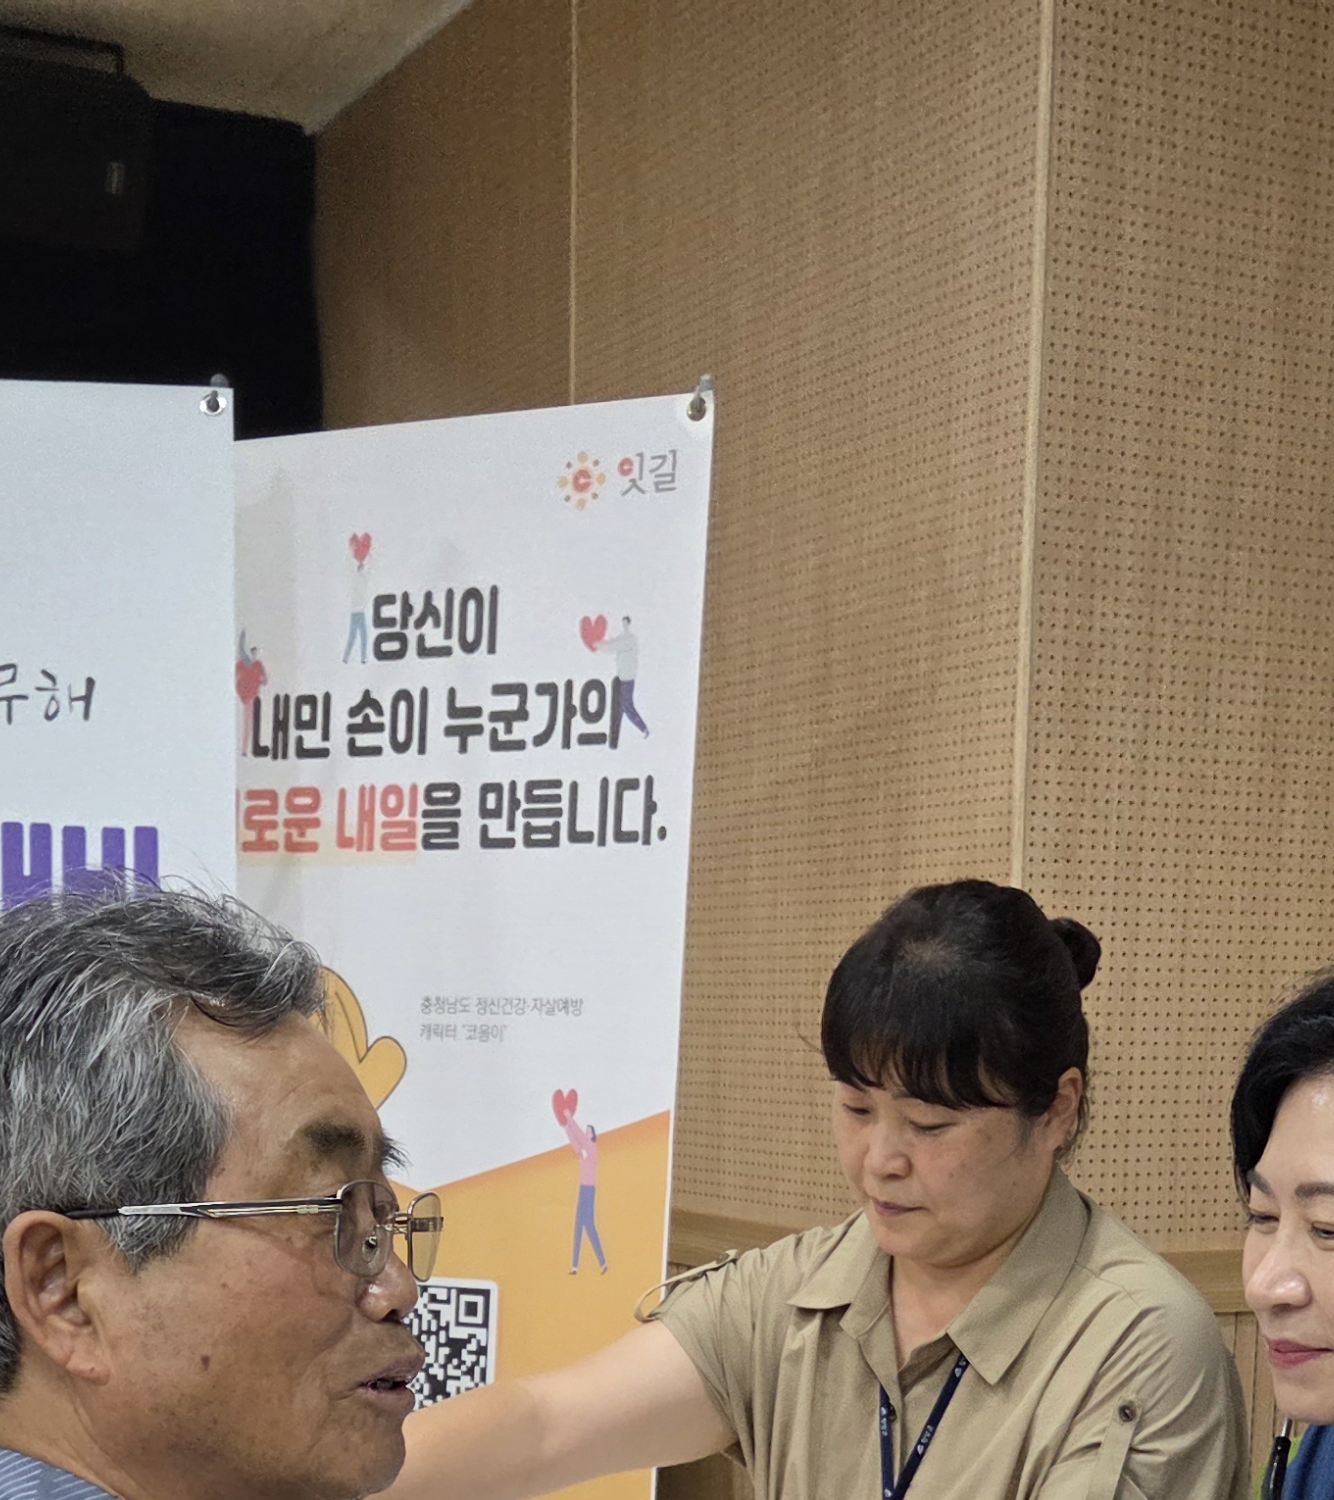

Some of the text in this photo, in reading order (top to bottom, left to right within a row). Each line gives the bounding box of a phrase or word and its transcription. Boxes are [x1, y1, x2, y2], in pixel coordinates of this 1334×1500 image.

[618, 449, 678, 497] 잇길
[372, 585, 499, 662] 당신이
[252, 677, 624, 760] 내민 손이 누군가의
[235, 774, 668, 853] 로운 내일을 만듭니다.
[420, 995, 471, 1015] 충청남도
